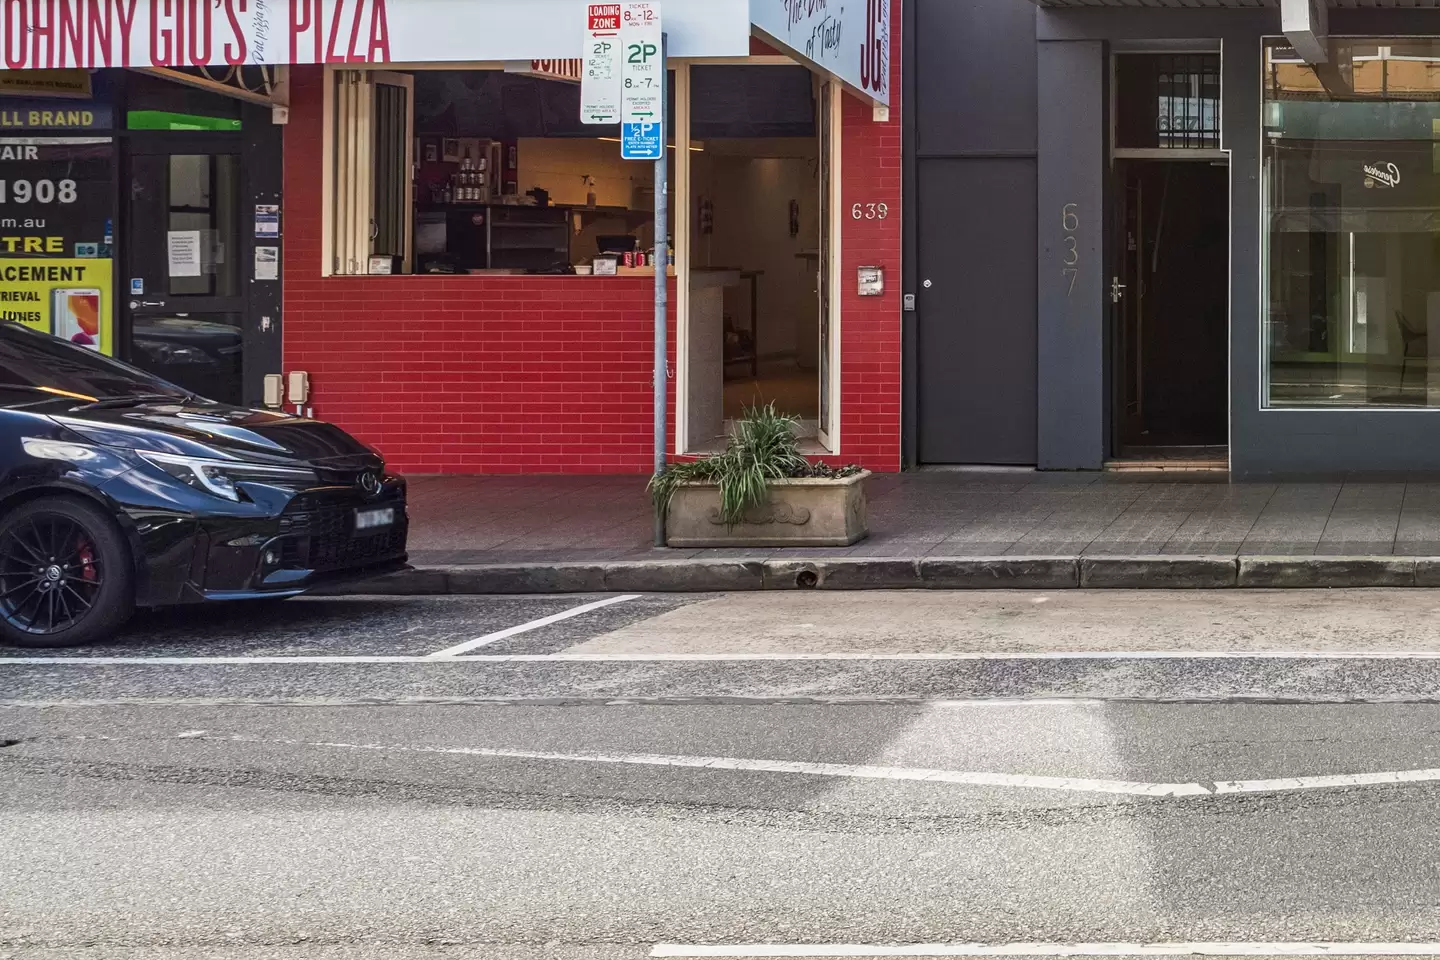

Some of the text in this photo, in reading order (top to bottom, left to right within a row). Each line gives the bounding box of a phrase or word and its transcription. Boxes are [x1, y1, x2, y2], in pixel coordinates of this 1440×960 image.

[590, 6, 620, 16] LOADING
[593, 18, 616, 28] ZONE
[594, 43, 611, 54] 2P
[805, 27, 816, 59] of
[628, 44, 657, 63] 2P
[0, 110, 94, 126] LL BRAND
[0, 145, 38, 160] AIR
[852, 203, 888, 219] 639
[2, 236, 64, 253] TRE
[1063, 203, 1079, 297] 637
